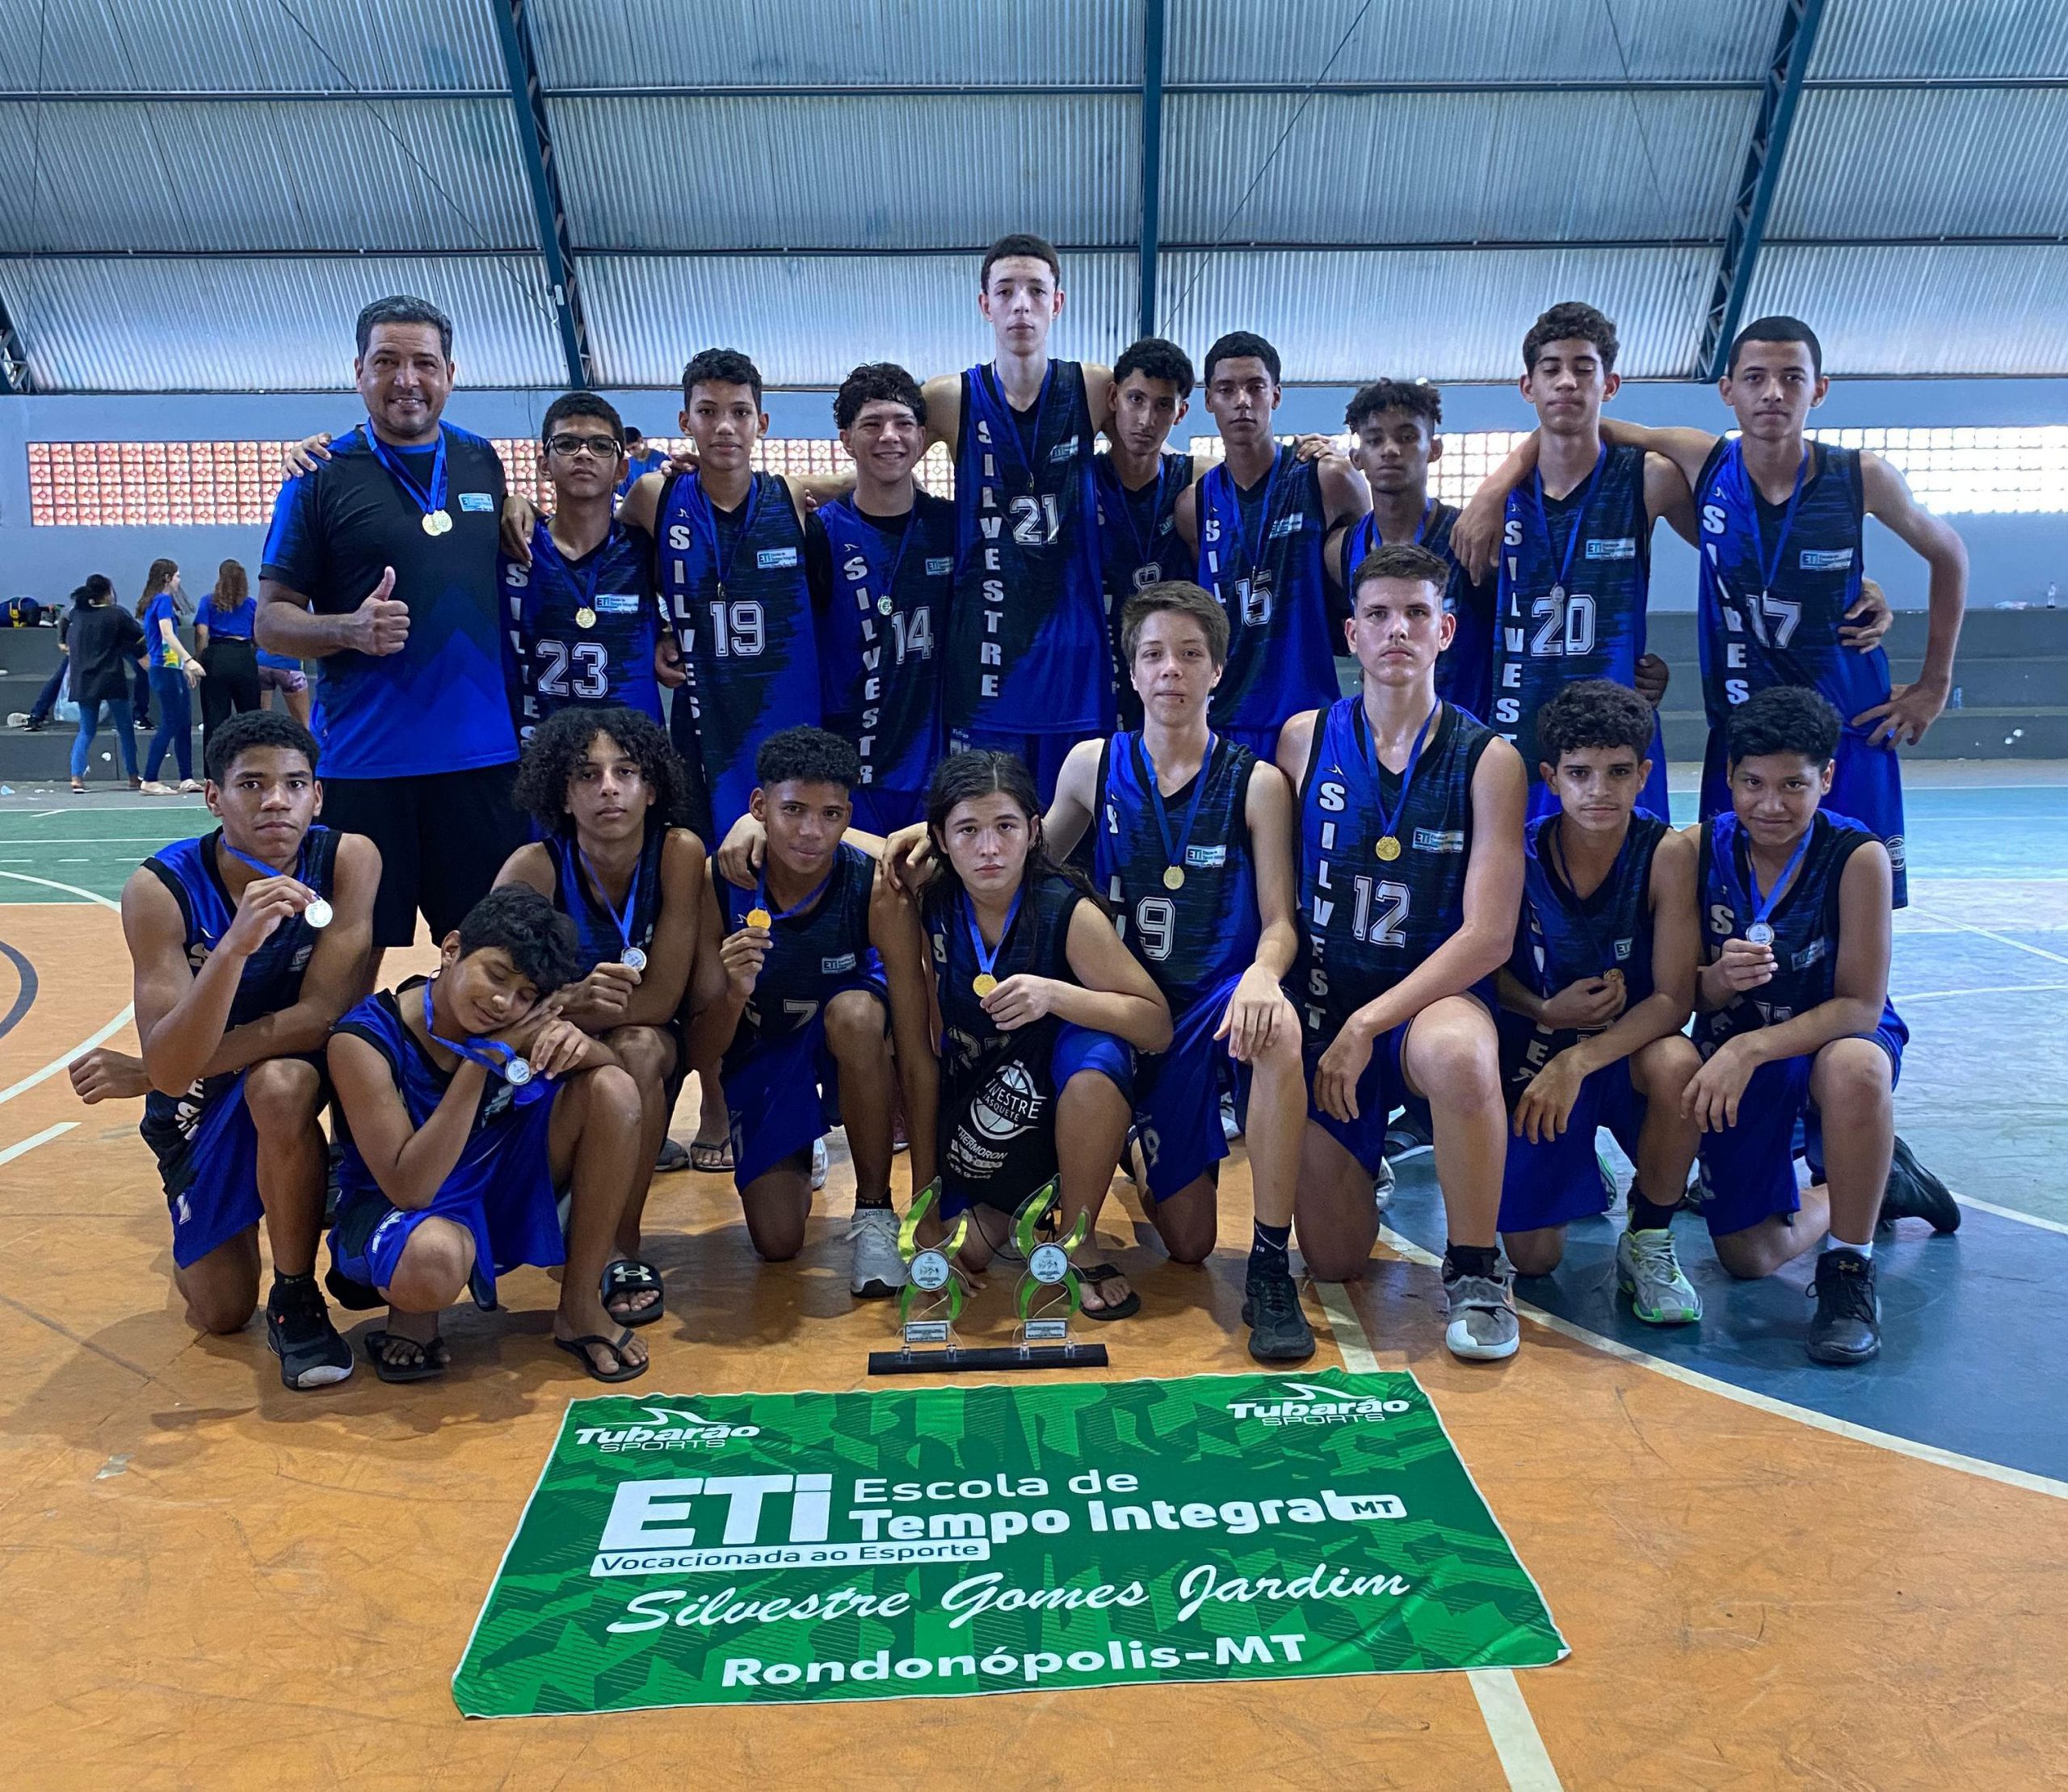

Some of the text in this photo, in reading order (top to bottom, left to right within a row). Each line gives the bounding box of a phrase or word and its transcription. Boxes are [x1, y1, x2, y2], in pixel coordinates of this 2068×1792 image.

[1010, 494, 1060, 545] 21
[977, 420, 1004, 697] SILVESTRE
[1235, 570, 1272, 627] 15
[1531, 594, 1595, 657] 20
[1746, 594, 1802, 649] 17
[710, 601, 766, 657] 19
[891, 606, 934, 664] 14
[536, 639, 607, 699] 23
[1136, 896, 1176, 961] 9
[1352, 875, 1410, 948] 12
[574, 1424, 760, 1446] Tubarão
[1225, 1398, 1410, 1419] Tubarão
[1262, 1413, 1385, 1426] SPORTS
[599, 1439, 725, 1453] SPORTS
[854, 1469, 1138, 1503] Escola de
[848, 1490, 1394, 1544] Tempo Integral MT
[601, 1542, 981, 1571] Vocacionada ao Esporte
[607, 1563, 1410, 1633] Silvestre Gomes Jardim
[722, 1634, 1306, 1686] Rondonópolis-MT
